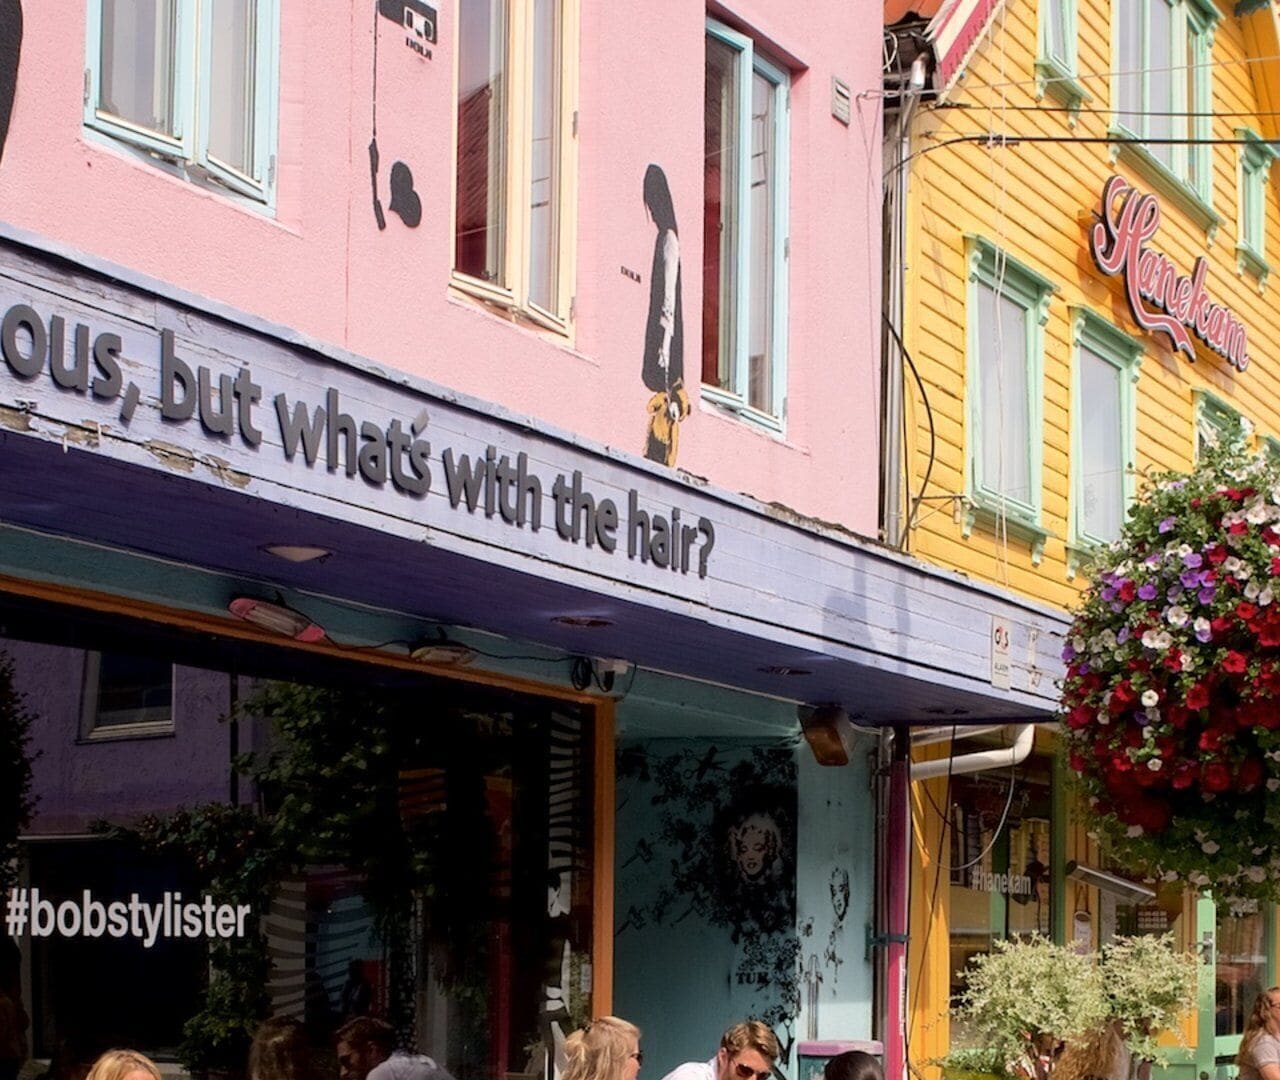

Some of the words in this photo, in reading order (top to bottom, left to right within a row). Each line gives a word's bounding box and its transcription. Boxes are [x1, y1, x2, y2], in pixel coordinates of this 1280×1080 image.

[1090, 175, 1249, 373] Hanekam
[161, 328, 262, 446] but
[443, 445, 542, 530] with
[552, 470, 619, 553] the
[628, 489, 716, 578] hair?
[5, 888, 251, 949] #bobstylister
[972, 865, 1032, 895] #hanekam
